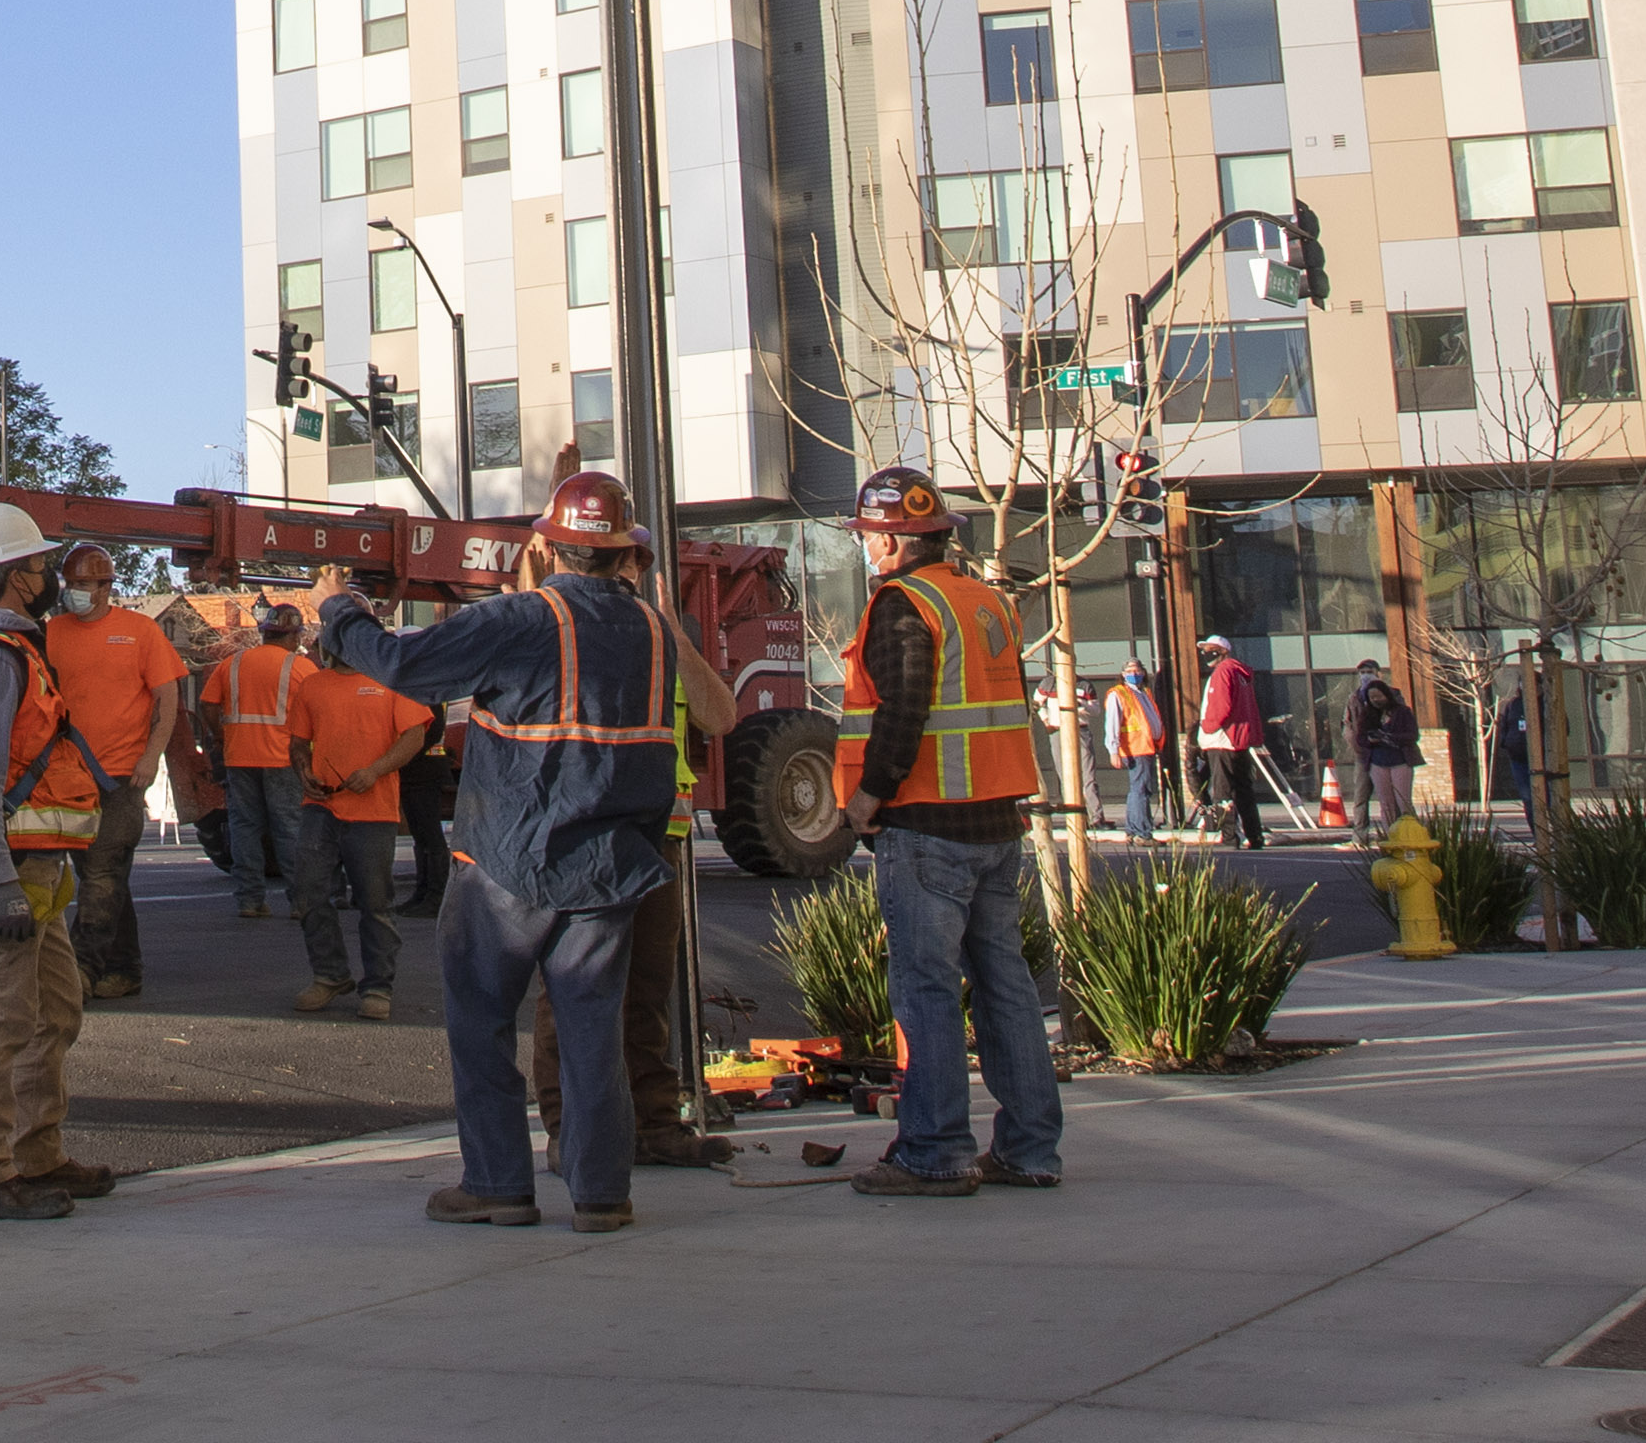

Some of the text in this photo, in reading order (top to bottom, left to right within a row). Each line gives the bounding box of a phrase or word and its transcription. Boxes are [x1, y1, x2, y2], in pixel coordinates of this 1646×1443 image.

[264, 525, 372, 553] A B C
[765, 644, 800, 659] 10042
